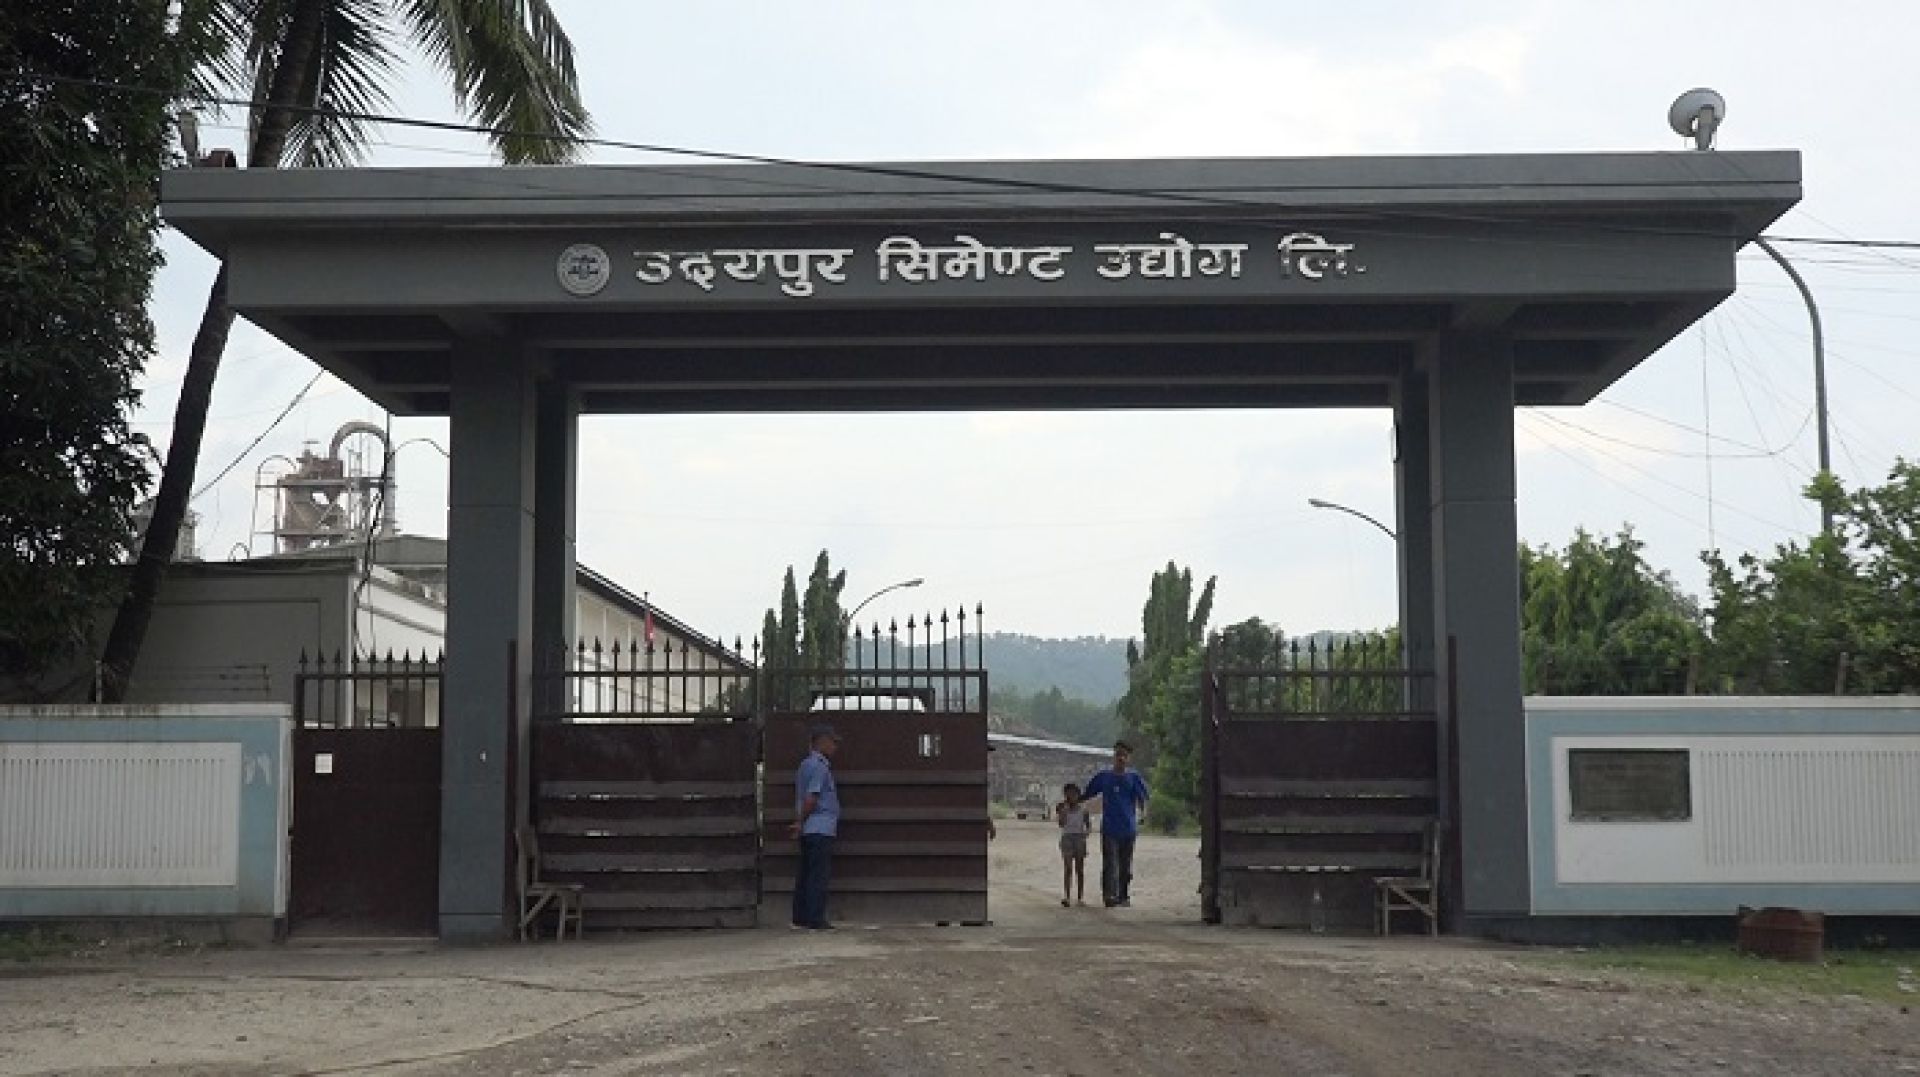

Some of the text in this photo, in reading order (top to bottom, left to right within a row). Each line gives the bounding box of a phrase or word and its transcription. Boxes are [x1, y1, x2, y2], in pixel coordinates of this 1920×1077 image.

[633, 248, 855, 296] उदयपुर
[876, 235, 1073, 281] सिमेण्ट
[1094, 232, 1249, 279] उद्योग
